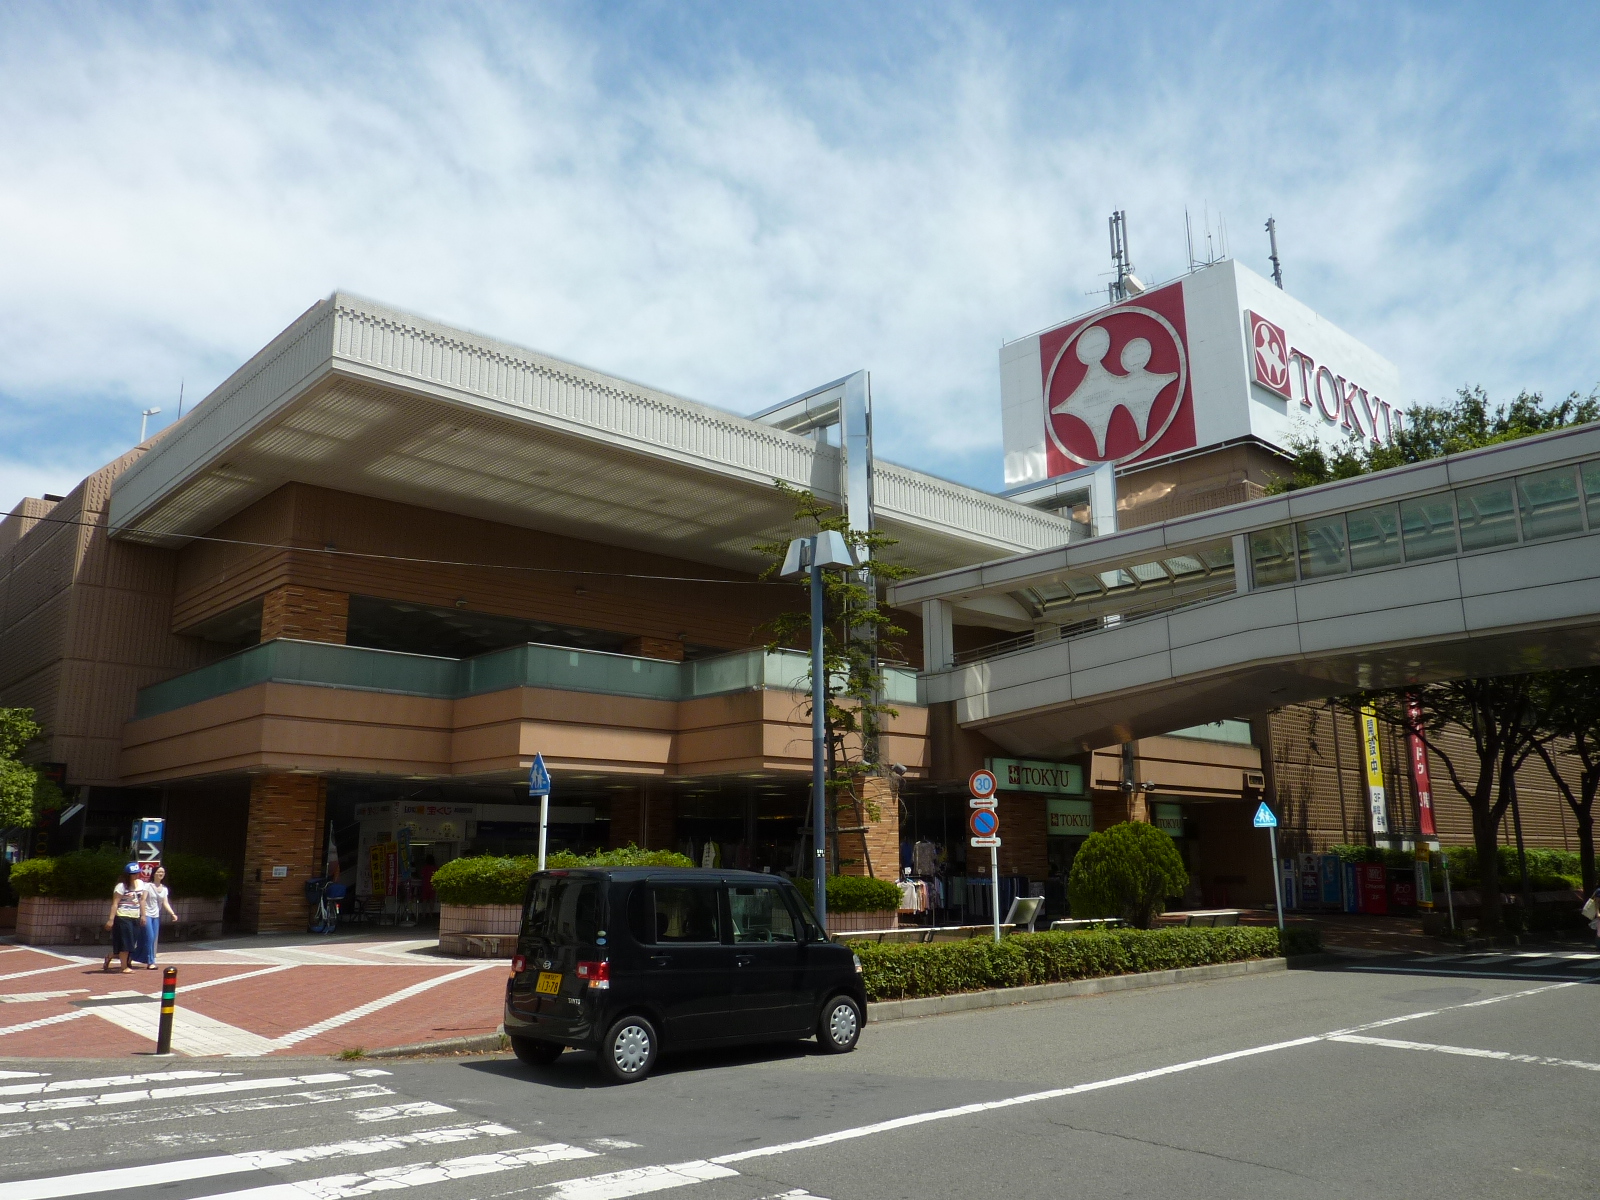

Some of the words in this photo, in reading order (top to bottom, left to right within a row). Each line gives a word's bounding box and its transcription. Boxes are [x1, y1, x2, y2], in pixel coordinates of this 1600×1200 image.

[974, 777, 990, 792] 30
[1021, 767, 1070, 788] TOKYU
[427, 806, 452, 815] 宝くじ
[1059, 813, 1092, 828] TOKYU
[1157, 818, 1181, 830] TOKYU
[143, 824, 159, 840] P
[1302, 875, 1317, 887] 本
